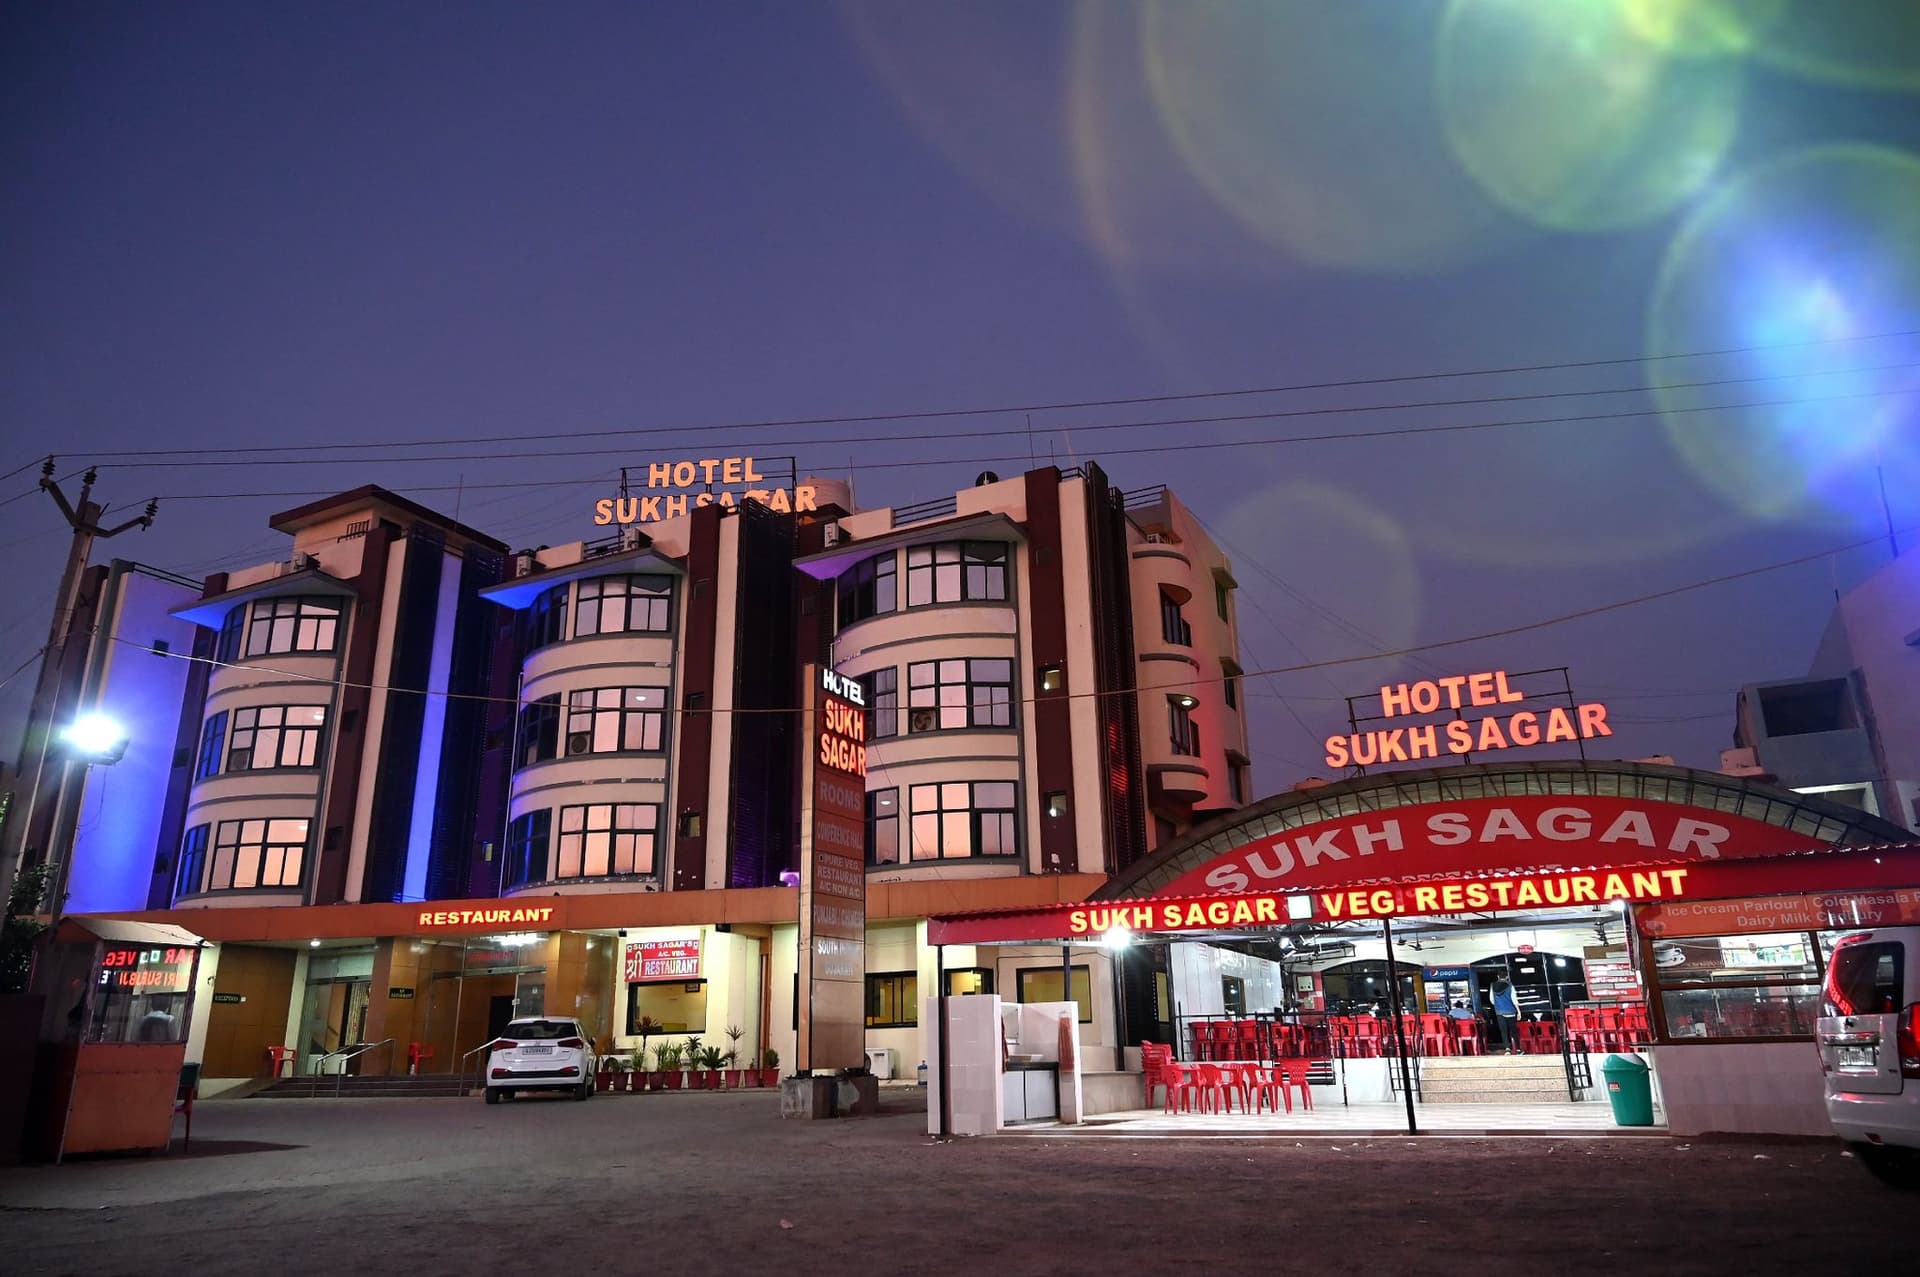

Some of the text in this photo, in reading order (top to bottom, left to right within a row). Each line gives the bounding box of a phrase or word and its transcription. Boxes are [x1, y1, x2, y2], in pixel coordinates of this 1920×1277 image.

[648, 457, 763, 488] HOTEL
[594, 495, 687, 525] SUKH
[823, 668, 865, 706] HOTEL
[1381, 671, 1523, 718] HOTEL
[825, 699, 864, 742] SUKH
[1325, 703, 1613, 768] SUKH SAGAR
[820, 733, 867, 777] SAGAR
[819, 782, 861, 811] ROOMS
[1205, 807, 1730, 893] SUKH SAGAR
[817, 866, 862, 885] RESTAURANT
[419, 907, 553, 925] RESTAURANT
[1070, 905, 1152, 933] SUKH
[1164, 897, 1279, 928] SAGAR
[1321, 884, 1405, 918] VEG.
[1415, 869, 1688, 912] RESTAURANT
[1667, 906, 1688, 917] Ice
[1692, 903, 1740, 915] Cream
[1743, 898, 1800, 912] Parlour
[1812, 895, 1849, 907] Cold
[1854, 893, 1909, 906] Masala
[1737, 915, 1776, 928] Dairy
[1781, 912, 1810, 924] Milk
[633, 942, 656, 951] SUKH
[644, 958, 698, 976] RESTAURANT
